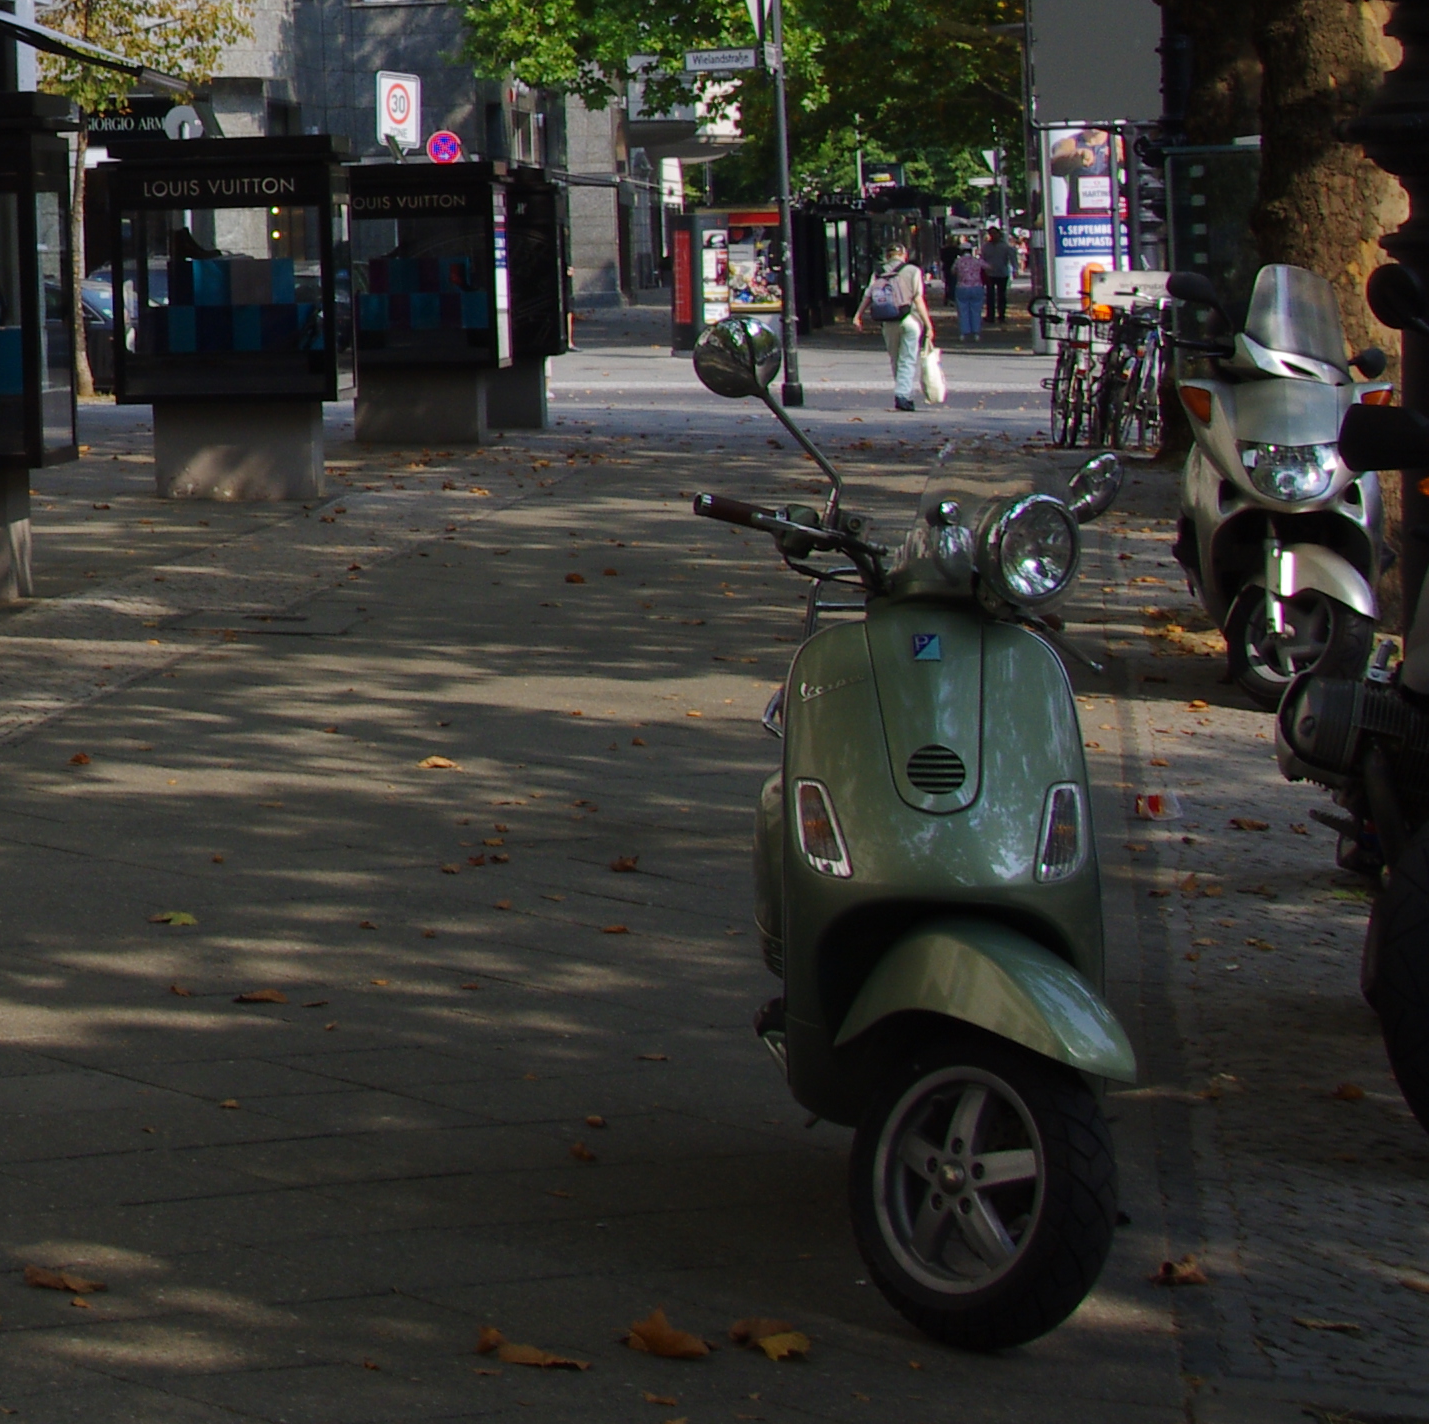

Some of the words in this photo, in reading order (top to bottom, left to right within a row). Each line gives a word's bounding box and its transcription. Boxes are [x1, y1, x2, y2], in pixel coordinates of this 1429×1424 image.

[692, 52, 749, 65] Wielandstraße
[391, 94, 406, 114] 30
[143, 179, 201, 198] LOUIS
[207, 177, 296, 196] VUITTON
[352, 196, 391, 210] OUIS
[396, 194, 467, 210] VUITTON
